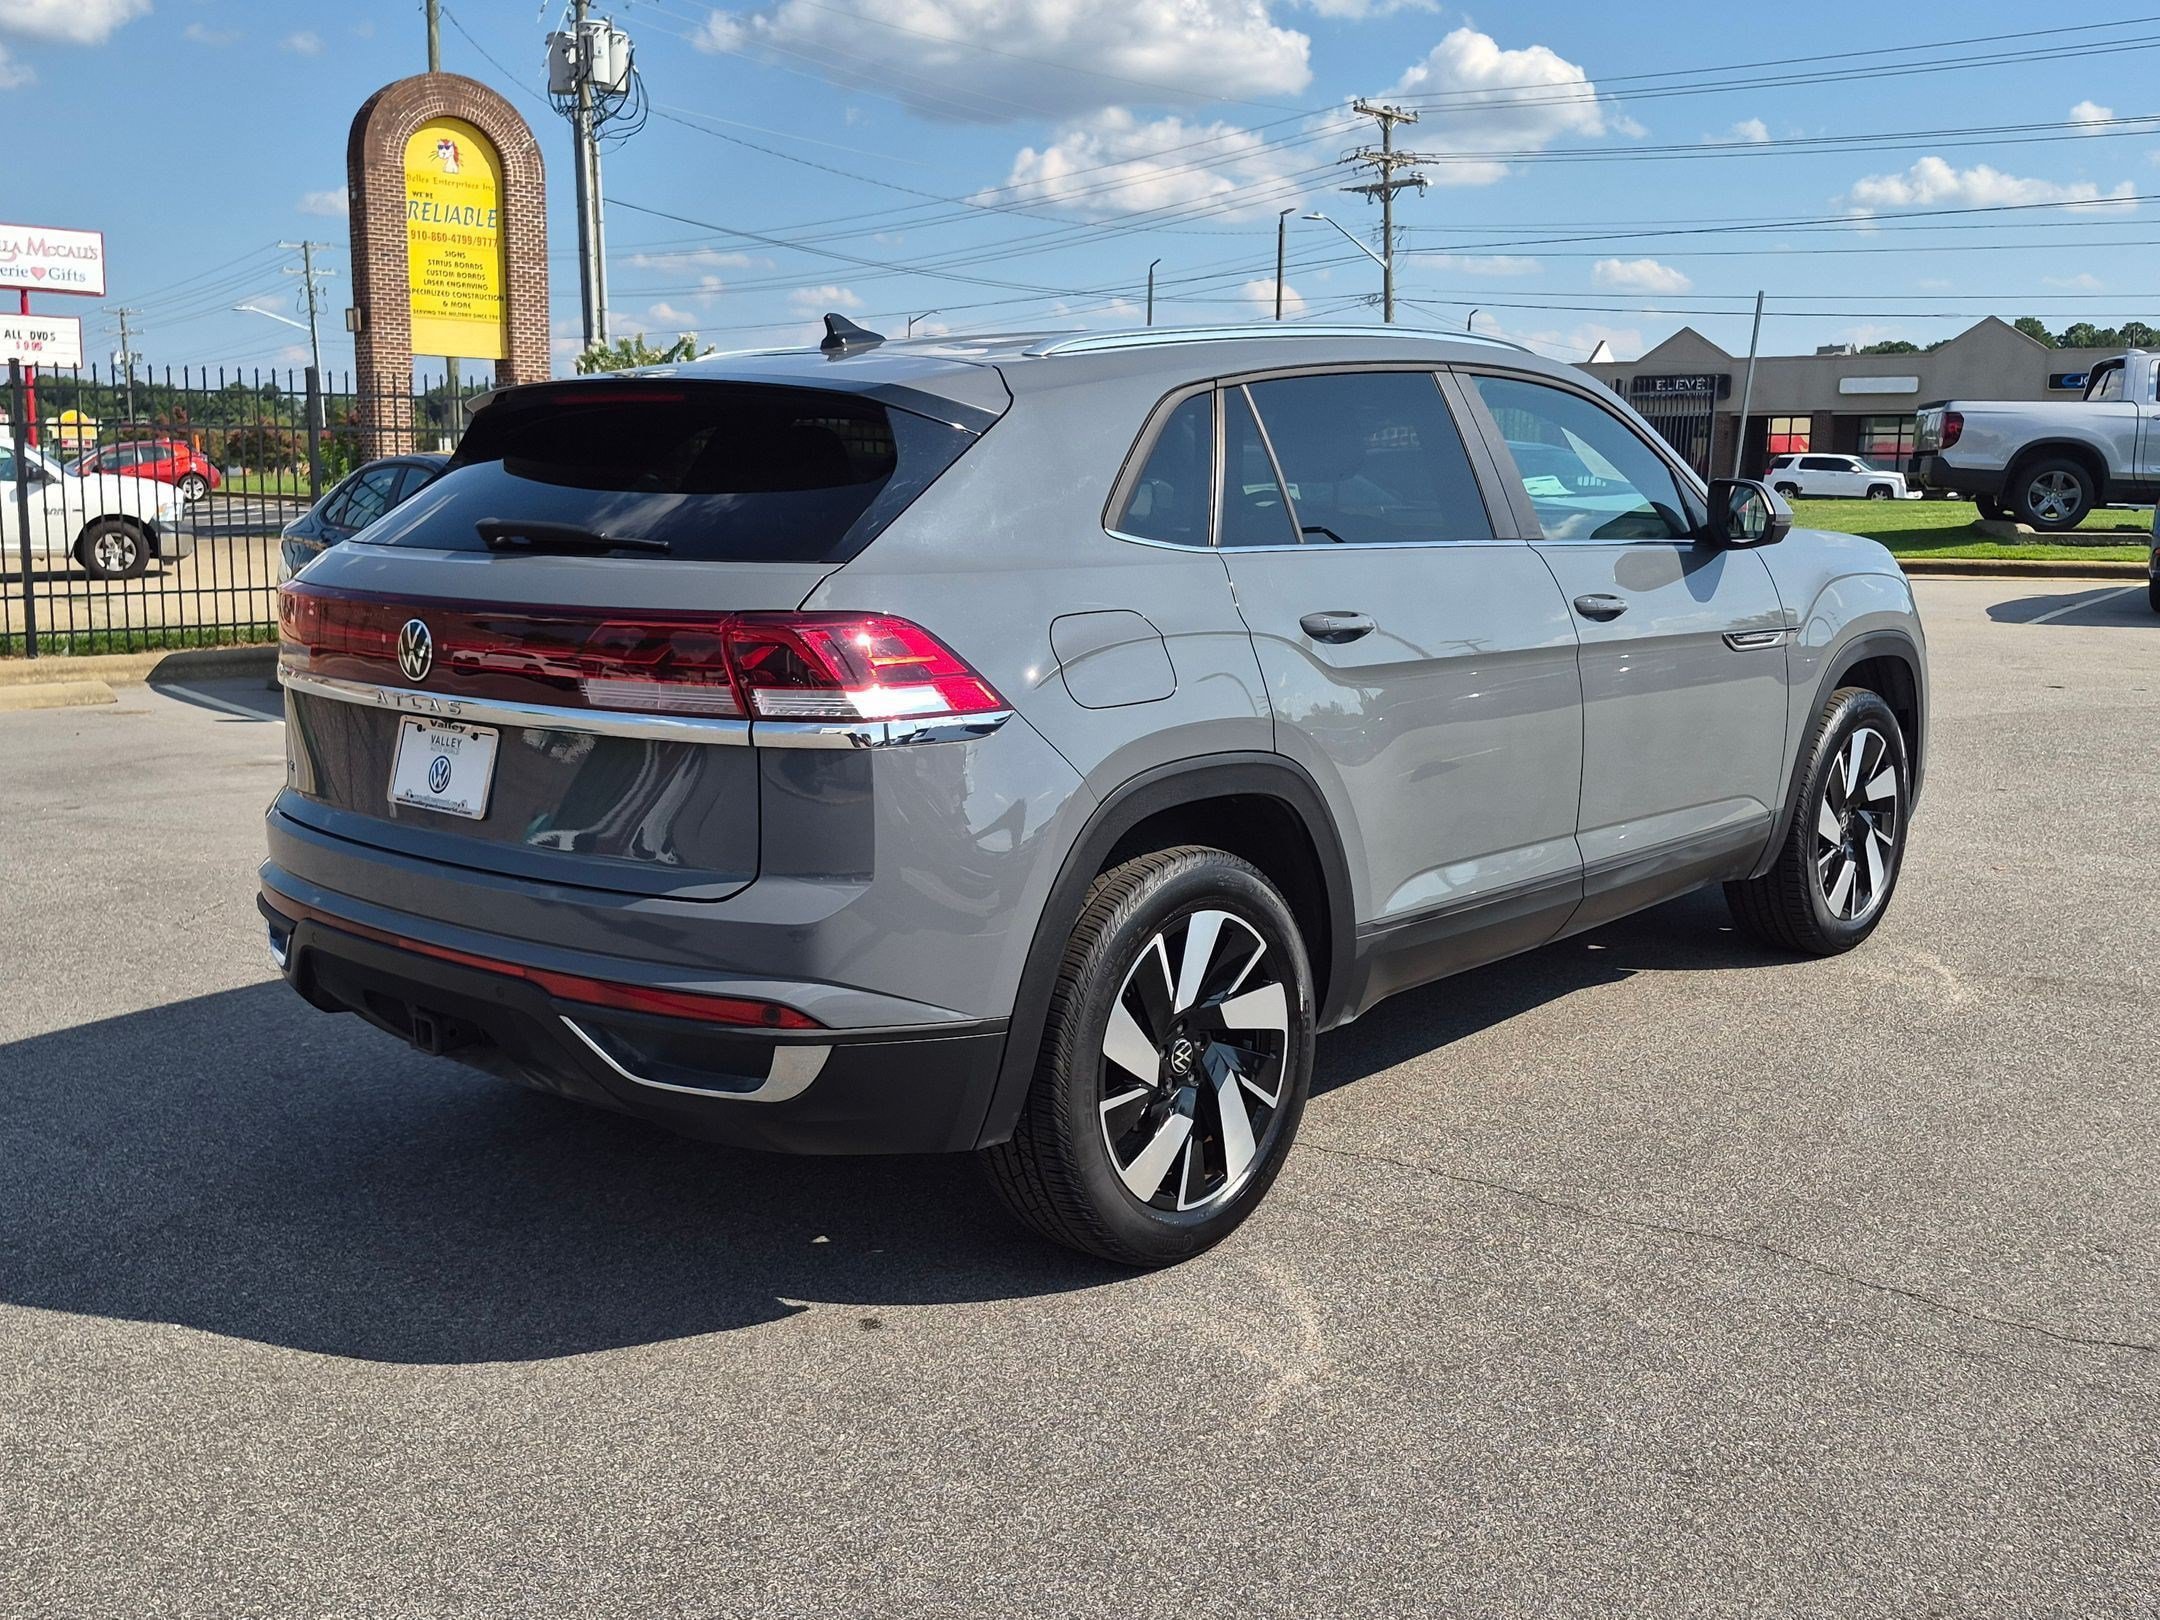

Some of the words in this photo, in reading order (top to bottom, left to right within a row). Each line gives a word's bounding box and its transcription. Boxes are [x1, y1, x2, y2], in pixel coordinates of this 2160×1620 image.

[407, 200, 497, 229] RELIABLE
[444, 250, 467, 260] SIGNS
[427, 259, 452, 269] STATUS
[454, 262, 484, 271] BOARDS
[48, 267, 87, 282] Gifts
[426, 269, 455, 279] CUSTOM
[456, 272, 486, 281] BOARDS
[423, 279, 445, 287] LASER
[446, 281, 489, 291] ENGRAVING
[410, 287, 450, 298] PECIALIZED
[452, 291, 504, 302] CONSTRUCTION
[450, 301, 472, 309] MORE
[4, 329, 23, 340] ALL
[377, 690, 462, 715] ATLAS
[429, 719, 466, 734] Valley
[430, 734, 463, 750] VALLEY
